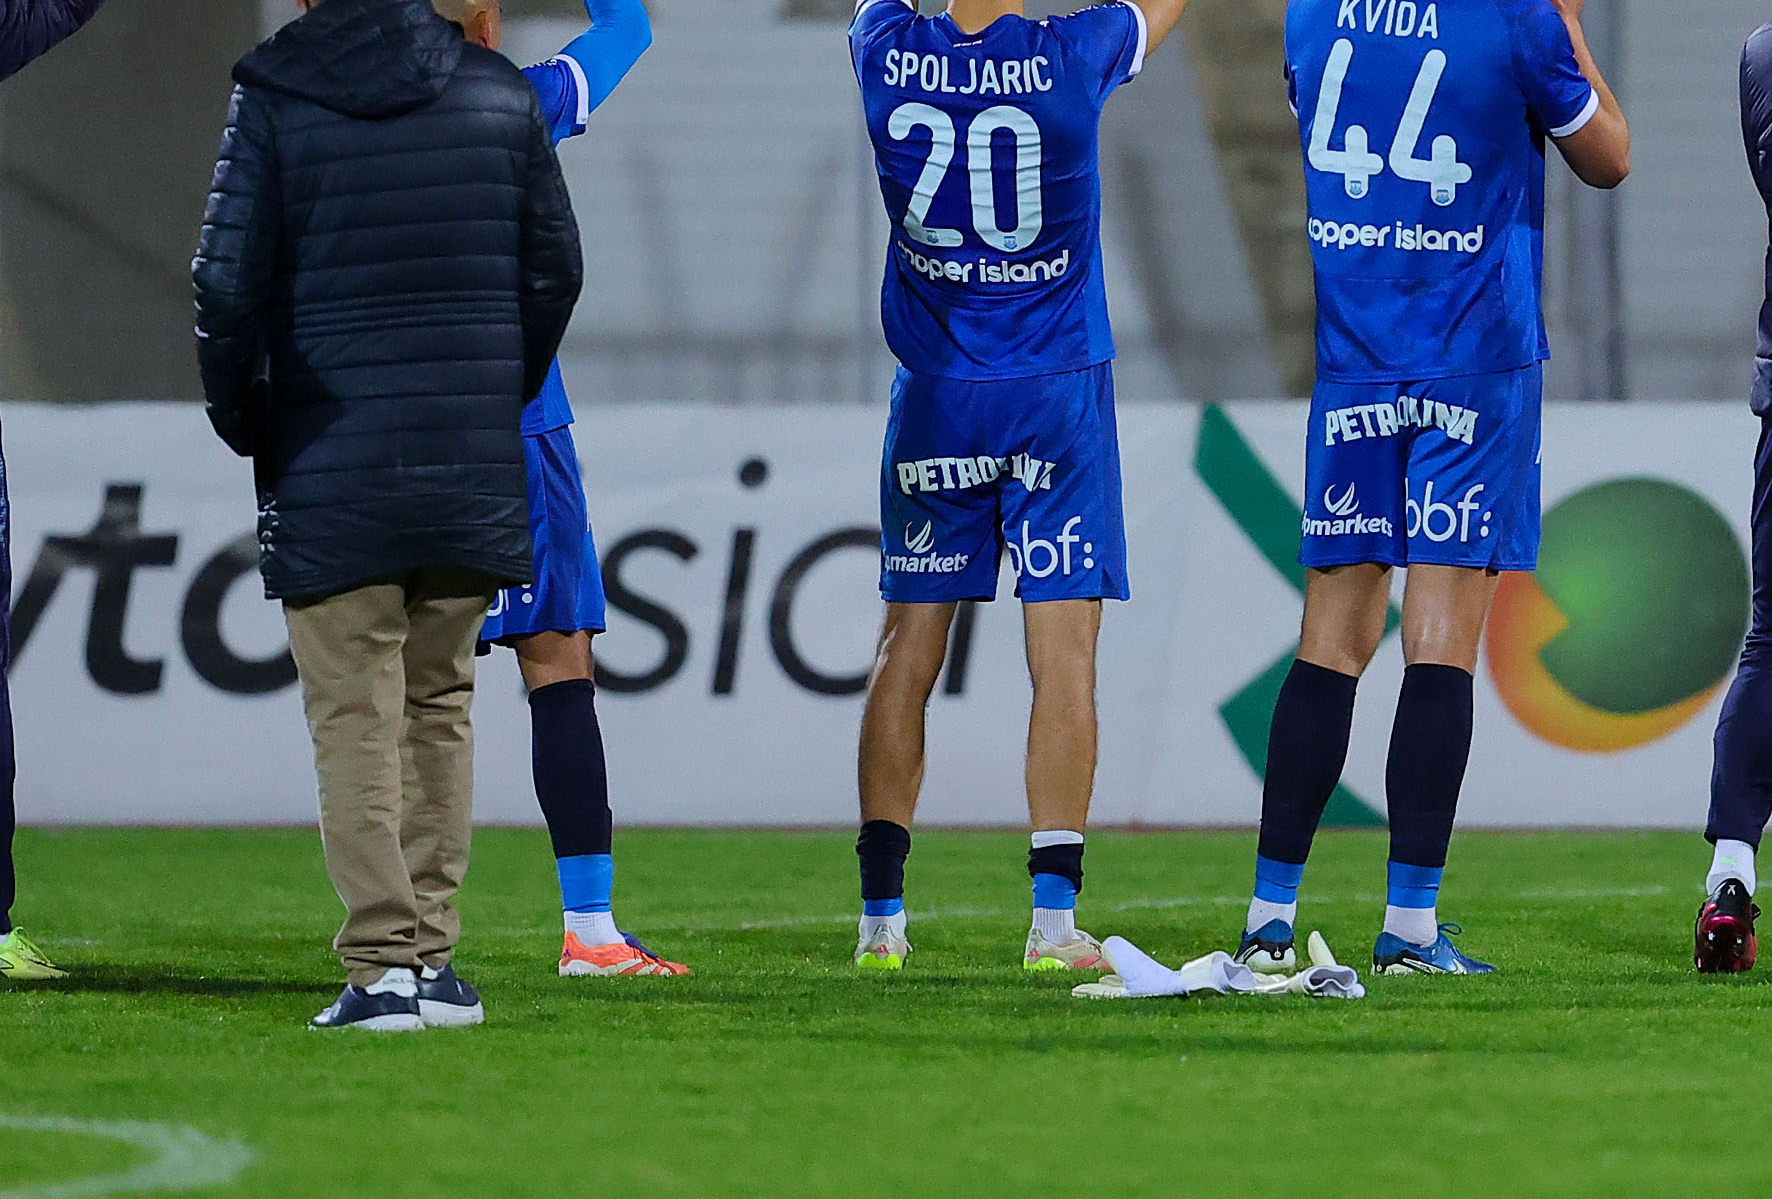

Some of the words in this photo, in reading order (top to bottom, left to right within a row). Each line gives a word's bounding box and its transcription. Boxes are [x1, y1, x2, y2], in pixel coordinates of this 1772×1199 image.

[883, 48, 1053, 95] SPOLJARIC
[1308, 38, 1473, 207] 44
[887, 102, 1044, 252] 20
[1395, 221, 1484, 253] island
[979, 249, 1069, 283] island
